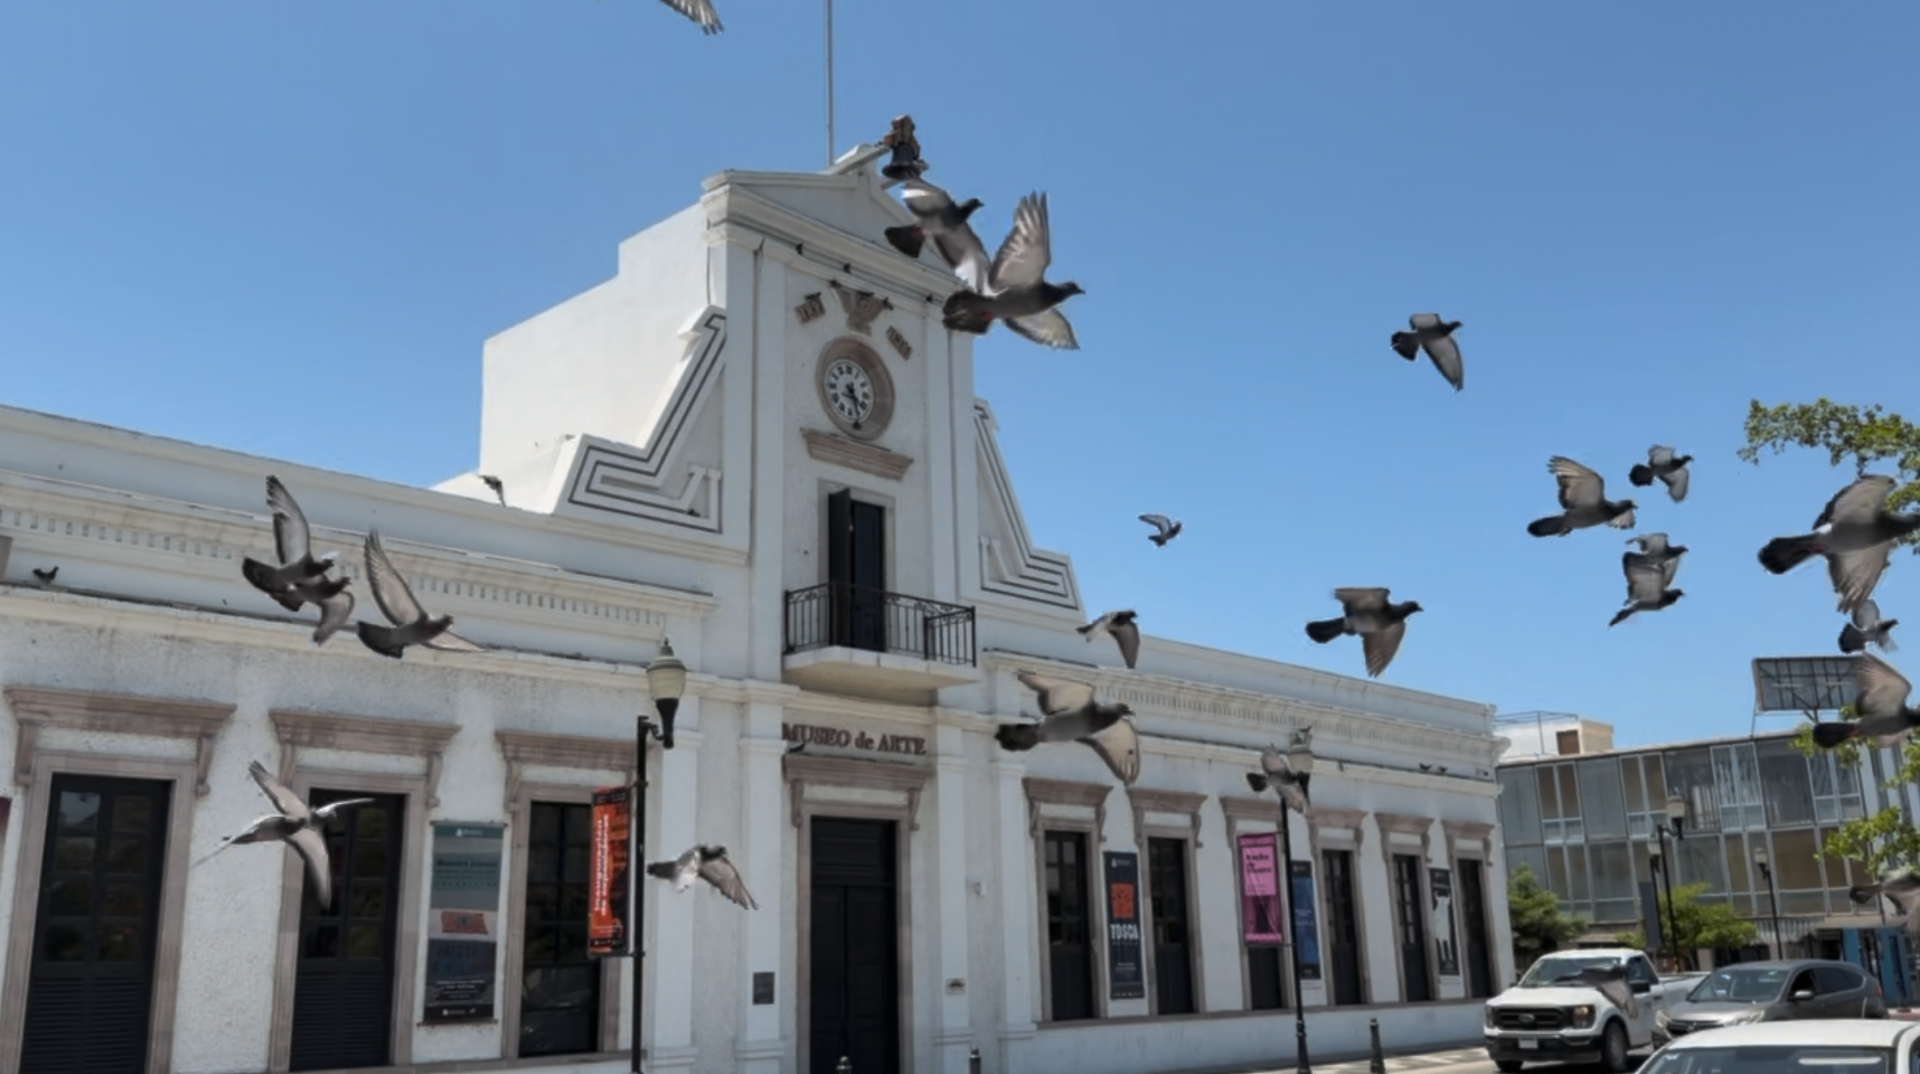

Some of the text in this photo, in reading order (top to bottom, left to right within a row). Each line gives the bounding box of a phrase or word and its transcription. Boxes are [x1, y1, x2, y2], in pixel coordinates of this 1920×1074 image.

[781, 722, 927, 755] MUSEO de ARTE
[1110, 923, 1140, 940] TOSCA
